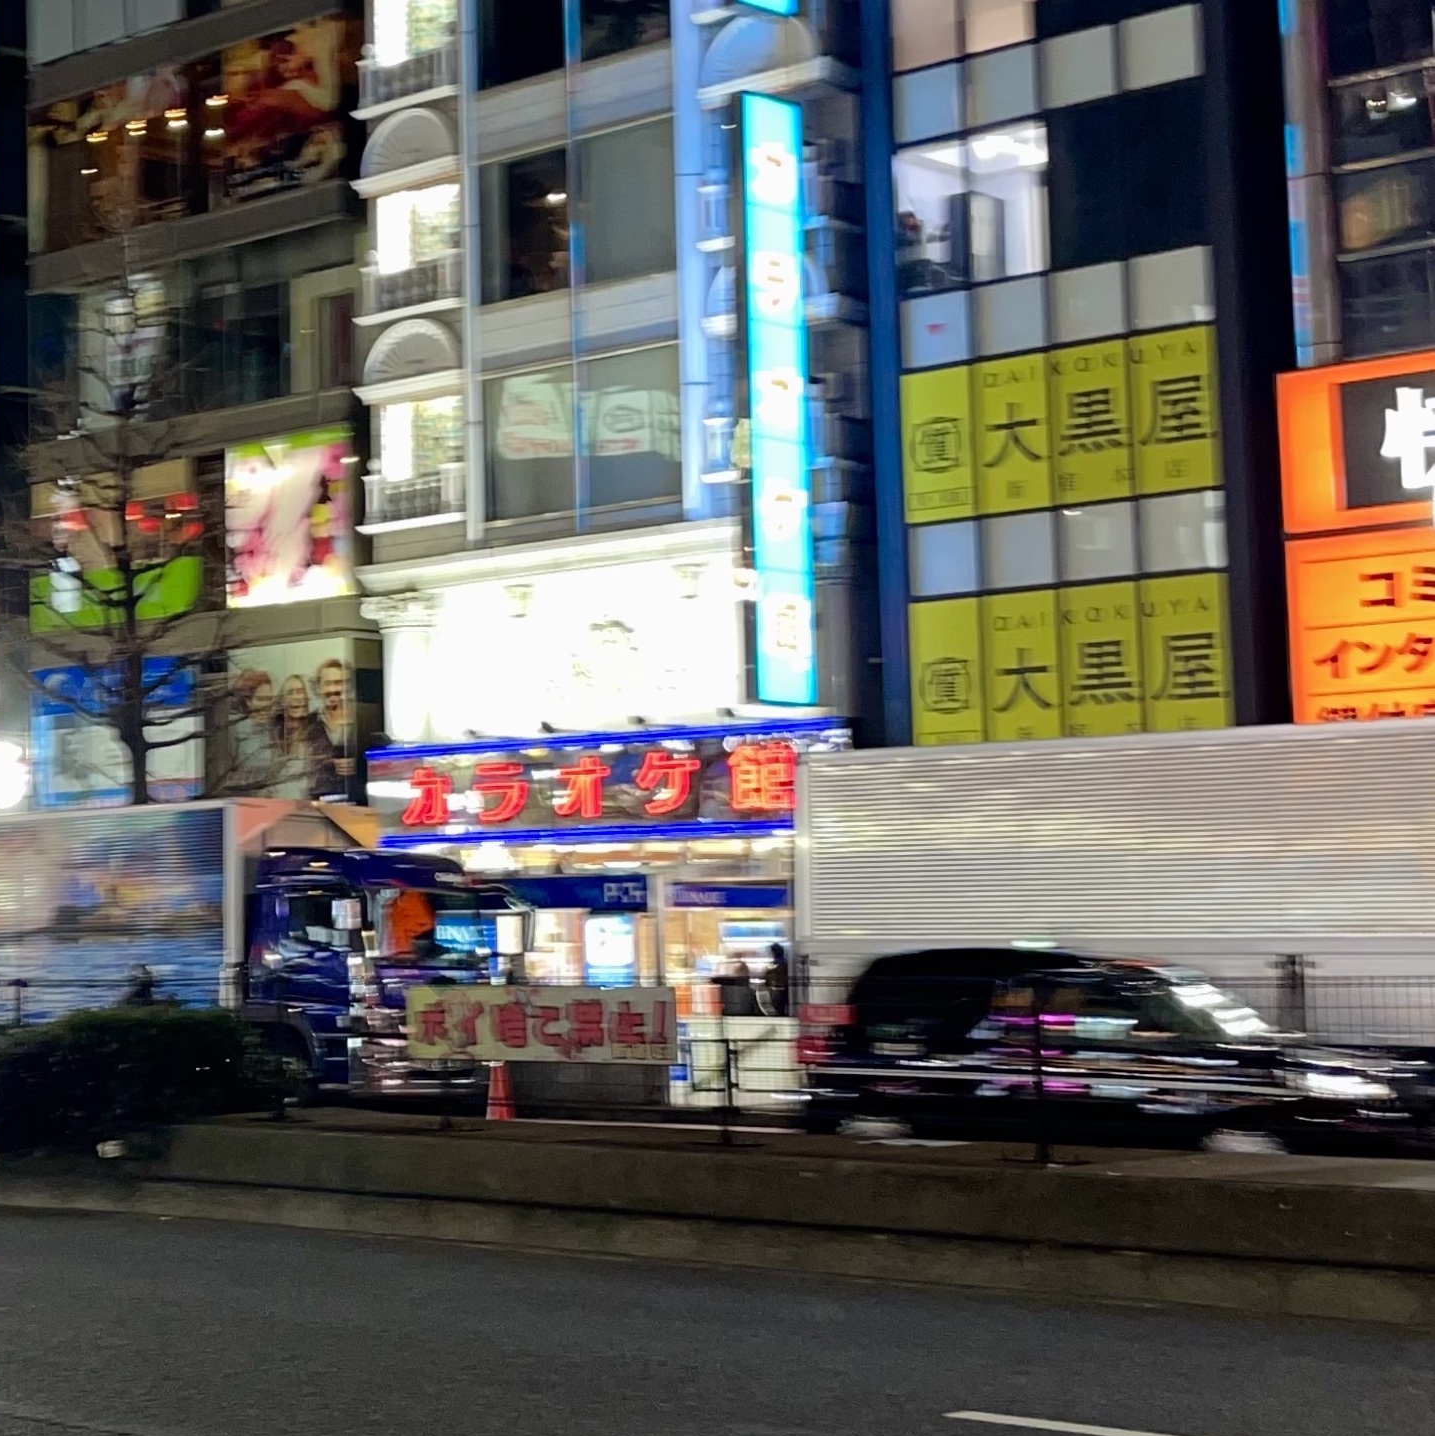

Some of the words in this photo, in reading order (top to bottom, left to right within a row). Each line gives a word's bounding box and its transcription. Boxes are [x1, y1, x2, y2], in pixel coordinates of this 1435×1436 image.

[981, 374, 1215, 468] 大黒屋
[992, 631, 1227, 711] 大黒屋
[402, 741, 797, 826] カラオケ館
